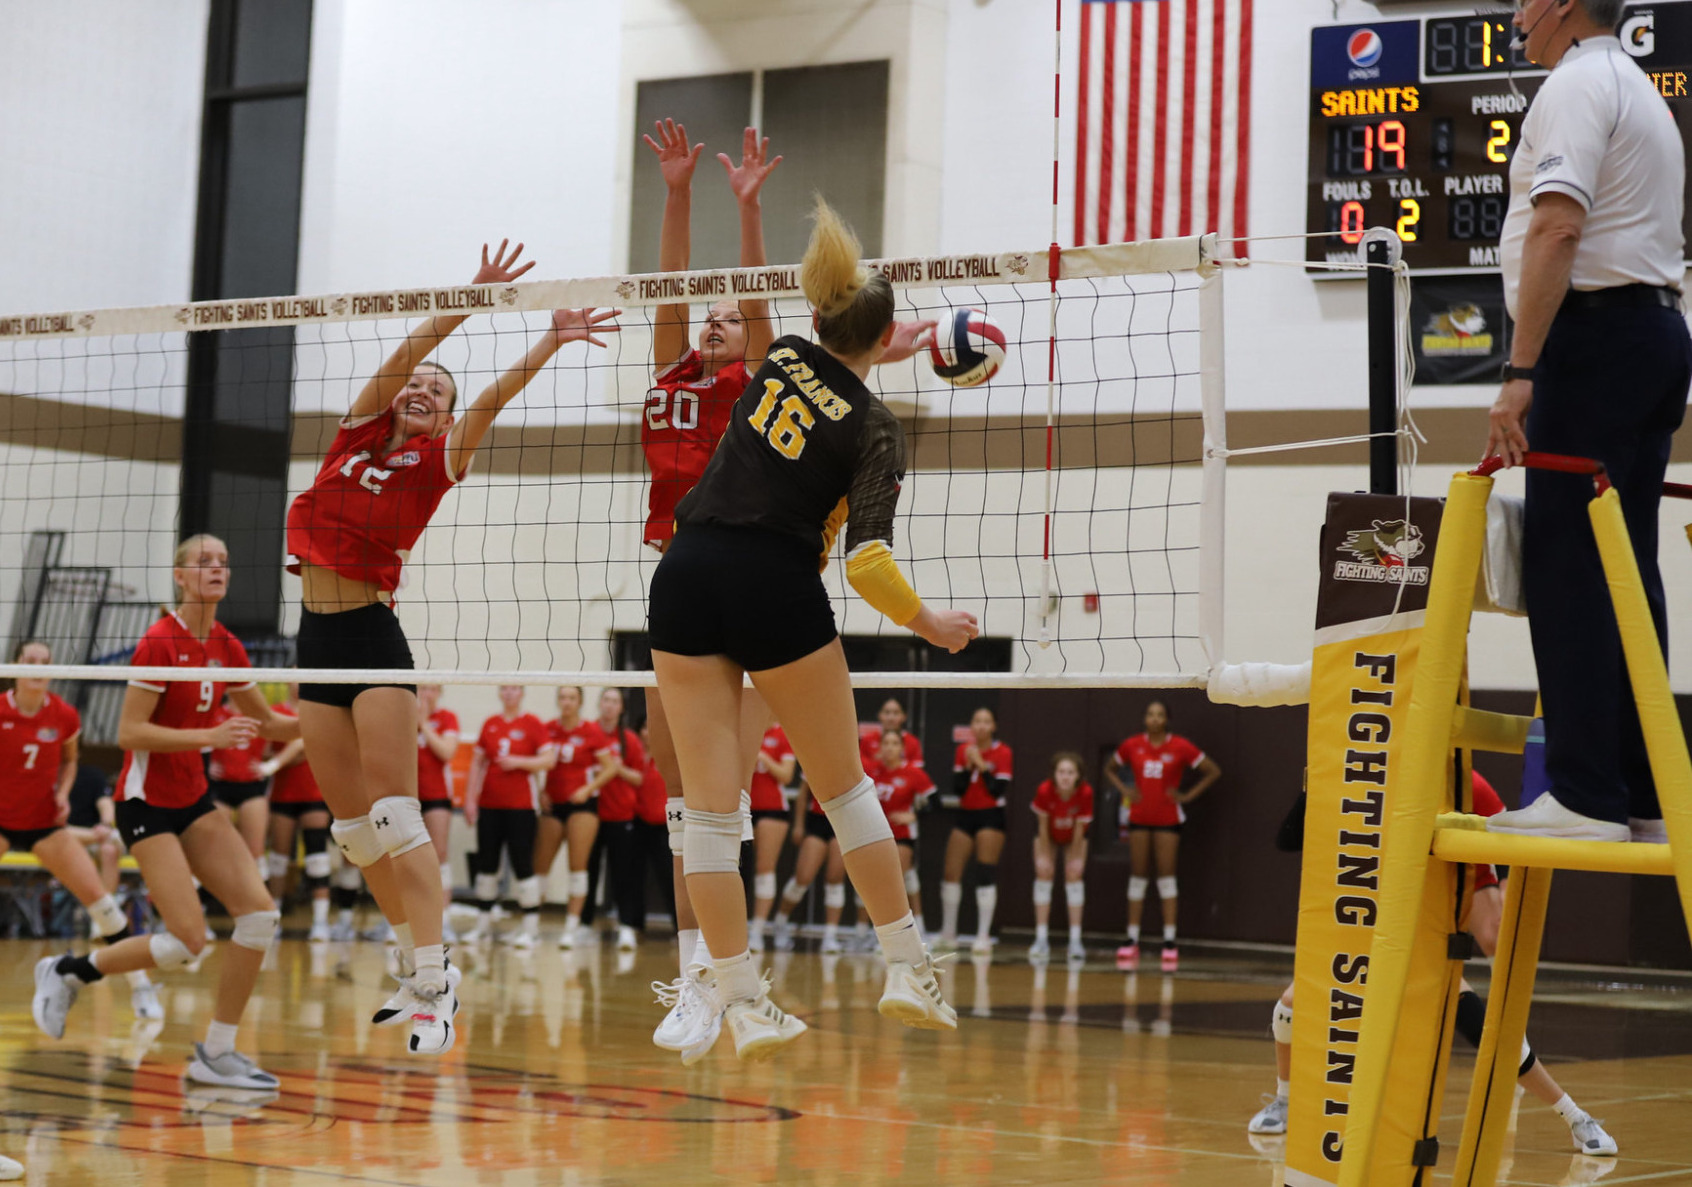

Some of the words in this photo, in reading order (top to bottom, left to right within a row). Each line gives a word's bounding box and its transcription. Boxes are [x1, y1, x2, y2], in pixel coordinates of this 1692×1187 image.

[1621, 15, 1654, 57] G
[1646, 71, 1688, 97] TER
[1321, 86, 1419, 117] SAINTS
[1472, 94, 1527, 115] PERIOD
[1364, 120, 1406, 172] 19
[1487, 120, 1510, 163] 2
[1323, 179, 1372, 201] FOULS
[1388, 178, 1430, 198] T.O.L.
[1445, 174, 1503, 196] PLAYER
[1341, 201, 1364, 244] 0
[1396, 199, 1420, 242] 2
[882, 262, 922, 282] SAINTS
[928, 257, 1000, 280] VOLLEYBALL
[1469, 247, 1500, 266] MAT
[639, 277, 684, 299] FIGHTING
[689, 275, 725, 295] SAINTS
[732, 271, 799, 293] VOLLEYBALL
[194, 306, 234, 324] FIGHTING
[237, 304, 267, 321] SAINTS
[352, 295, 393, 315] FIGHTING
[398, 292, 430, 311] SAINTS
[435, 289, 495, 309] VOLLEYBALL
[784, 362, 853, 421] FRANCIS
[645, 388, 699, 431] 20
[748, 378, 816, 460] 16
[1336, 562, 1386, 580] FIGHTING
[1389, 567, 1426, 583] SANTS
[196, 680, 213, 712] 9
[23, 744, 39, 769] 7
[1334, 652, 1397, 928] FIGHTING
